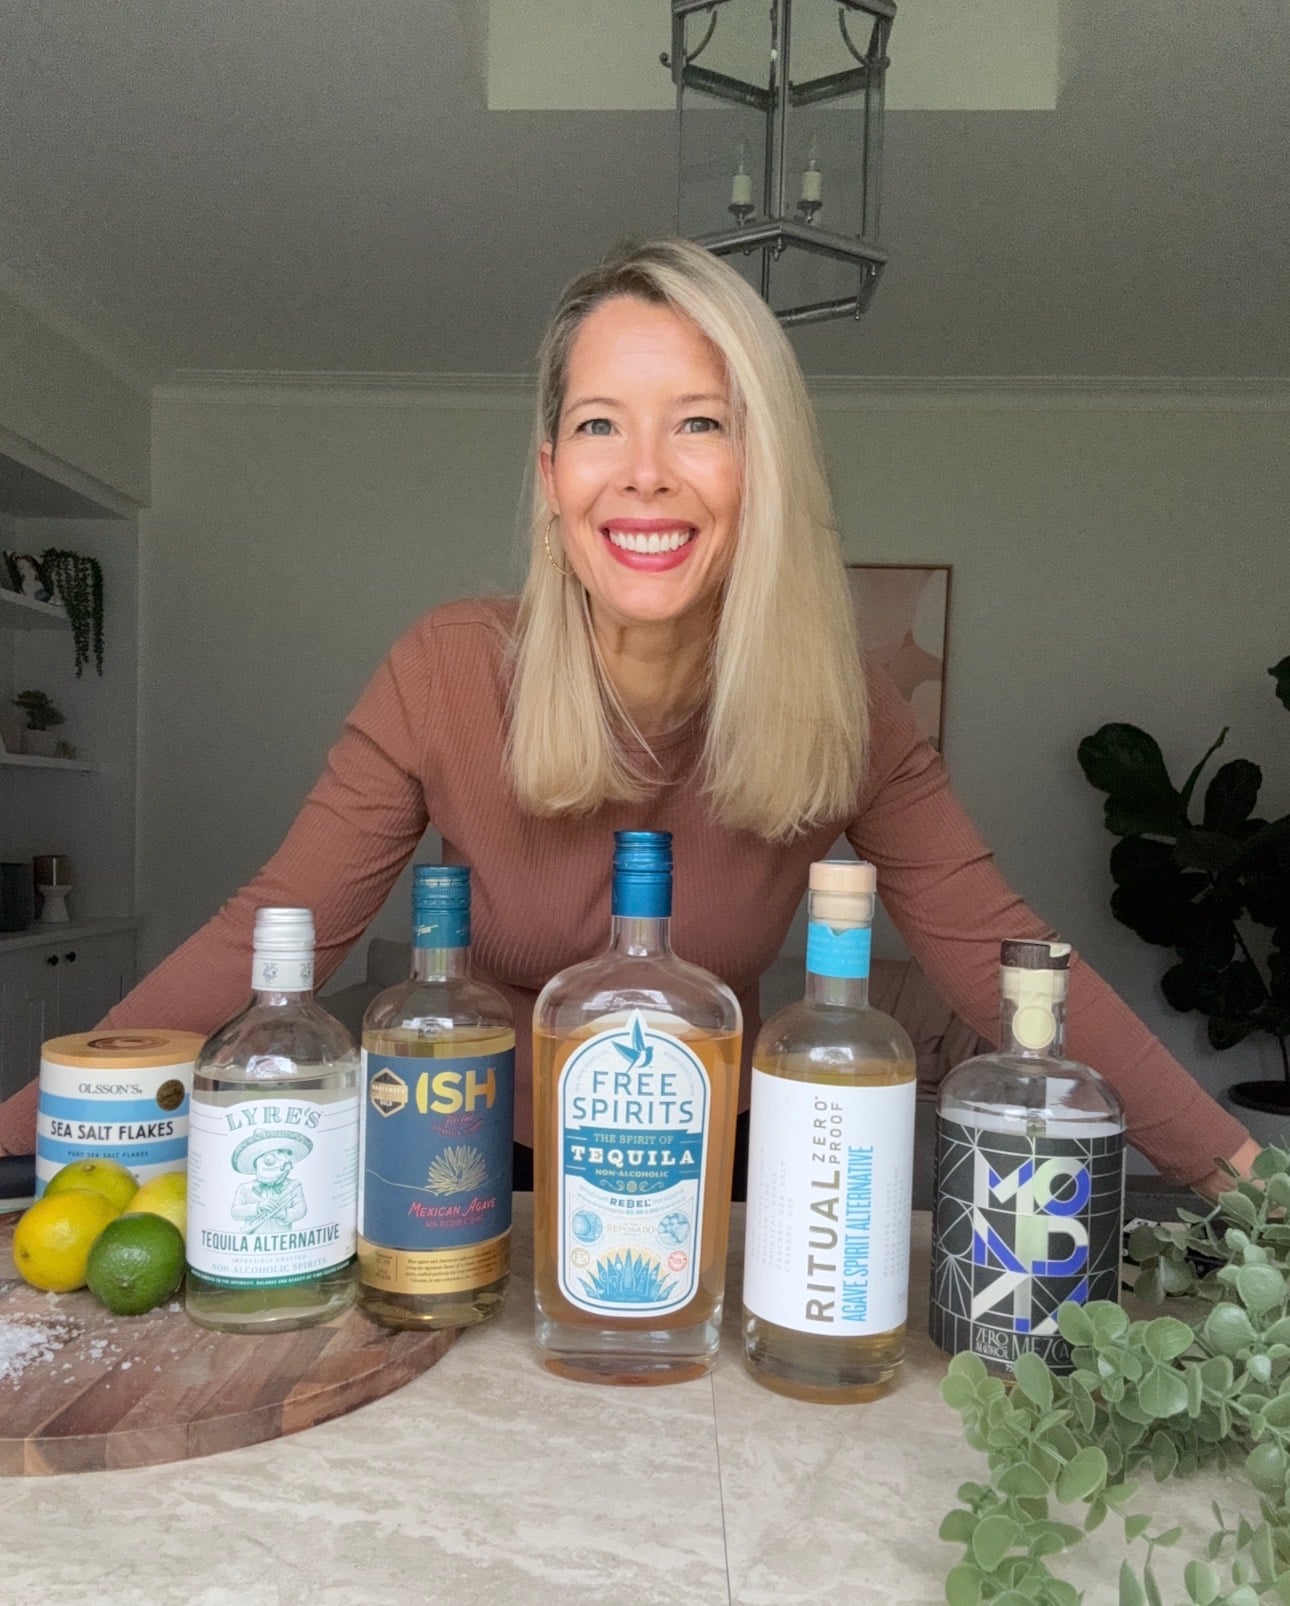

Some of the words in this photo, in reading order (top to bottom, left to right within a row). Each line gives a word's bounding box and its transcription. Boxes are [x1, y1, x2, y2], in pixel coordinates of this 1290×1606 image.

[78, 1083, 141, 1095] OLSSON'S
[415, 1067, 496, 1114] ISH
[593, 1070, 677, 1096] FREE
[225, 1106, 322, 1132] LYRE'S
[572, 1096, 694, 1125] SPIRITS
[50, 1120, 73, 1138] SEA
[77, 1124, 113, 1141] SALT
[118, 1121, 174, 1141] FLAKES
[592, 1132, 617, 1144] THE
[619, 1135, 657, 1145] SPIRIT
[658, 1135, 675, 1145] OF
[812, 1100, 828, 1163] ZERO
[829, 1102, 844, 1165] PROOF
[570, 1145, 695, 1168] TEQUILA
[595, 1168, 670, 1178] NON-ALCOHOLIC
[846, 1145, 875, 1230] ALTERNATIVE
[408, 1201, 461, 1219] MEXICAN
[461, 1196, 496, 1217] AGAVE
[609, 1197, 652, 1209] REBEL
[201, 1230, 249, 1252] TEQUILA
[253, 1223, 340, 1252] ALTERNATIVE
[805, 1170, 841, 1323] RITUAL
[211, 1262, 290, 1275] NON-ALCOHOLIC
[291, 1257, 327, 1272] SPIRITS
[843, 1233, 871, 1278] SPIRIT
[841, 1279, 868, 1323] AGAVE
[974, 1326, 1009, 1349] ZERO
[975, 1341, 1011, 1360] ALCOHOL
[1012, 1334, 1073, 1364] MEZCA
